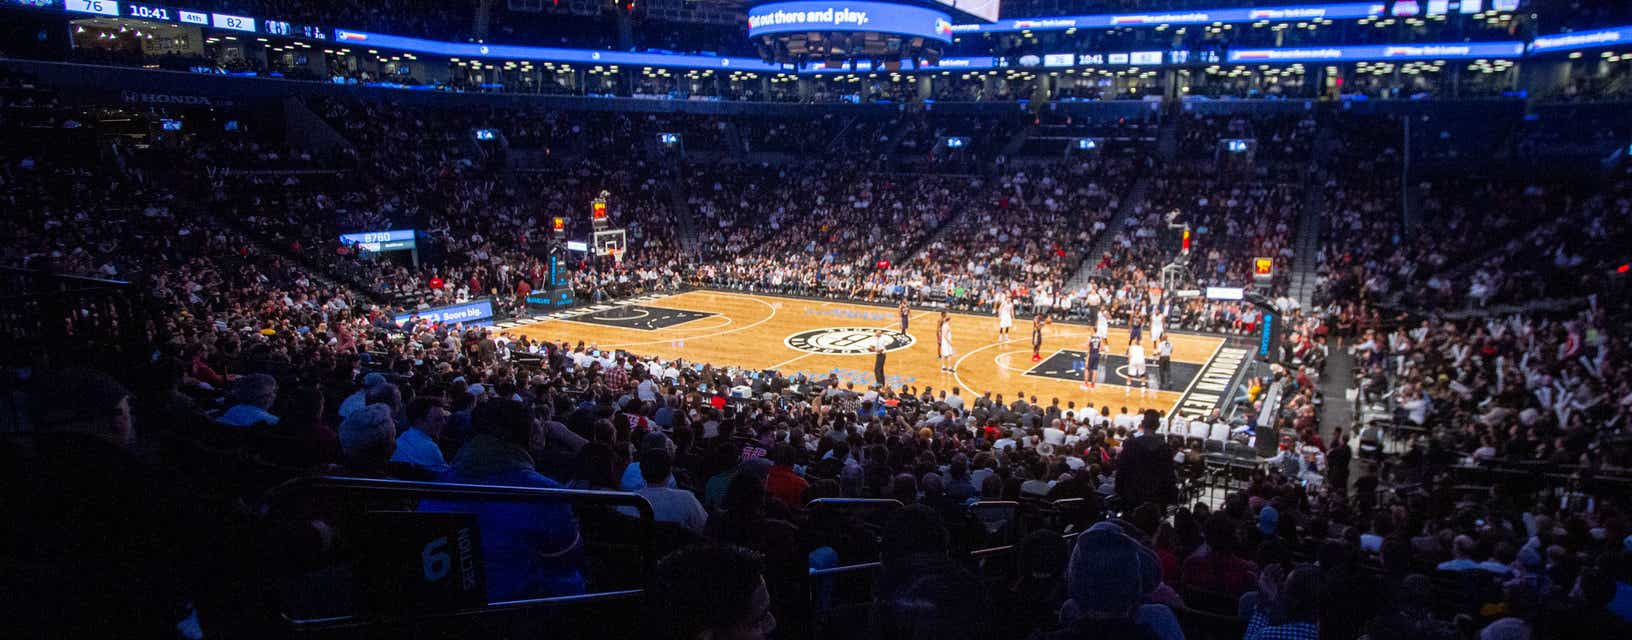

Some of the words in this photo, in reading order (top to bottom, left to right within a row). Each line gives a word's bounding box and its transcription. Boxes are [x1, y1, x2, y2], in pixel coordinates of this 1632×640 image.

[82, 0, 103, 12] 76
[130, 5, 171, 20] 10:41
[186, 14, 202, 23] 4th
[226, 17, 242, 29] 82
[761, 13, 774, 25] out
[775, 10, 805, 24] there
[807, 8, 833, 22] and
[834, 8, 868, 25] play.
[142, 94, 211, 105] HONDA
[443, 312, 467, 321] Score
[467, 307, 482, 317] big.
[423, 536, 449, 584] 6
[456, 528, 476, 592] SECTION
